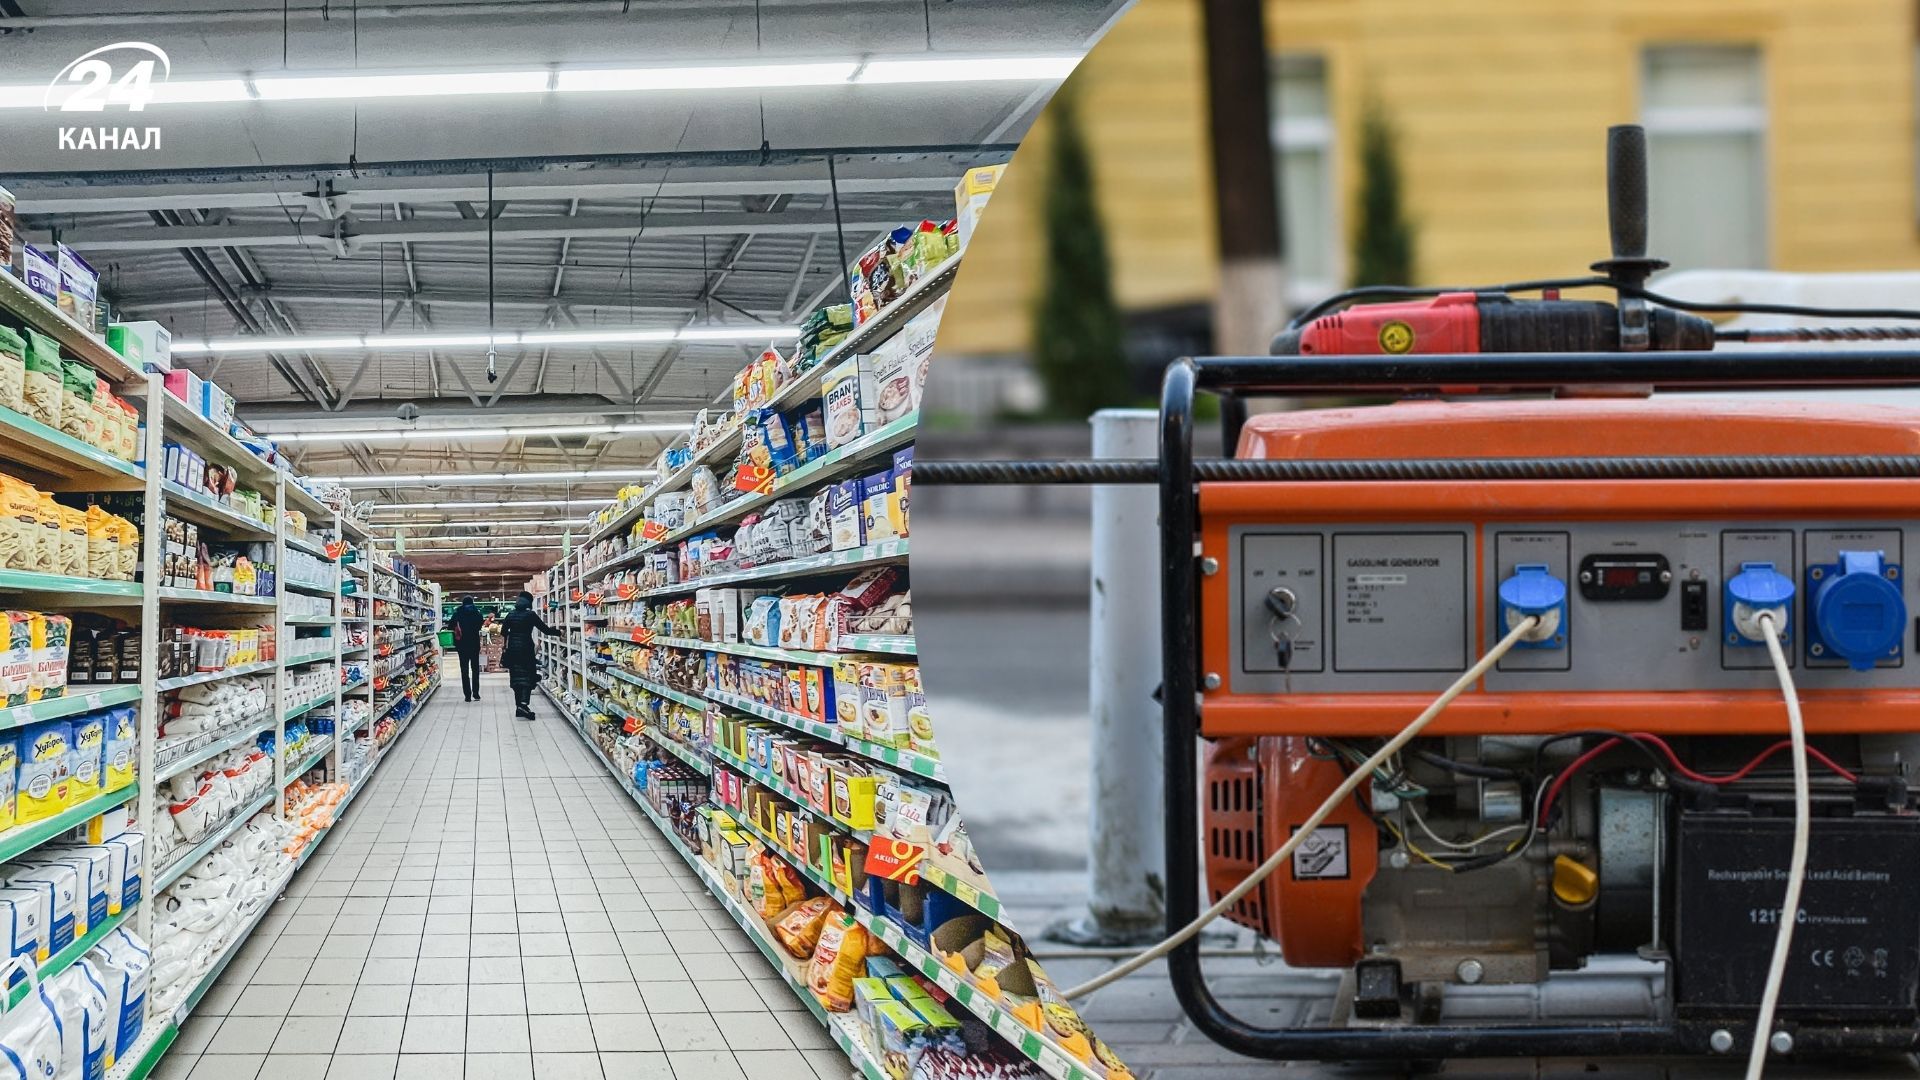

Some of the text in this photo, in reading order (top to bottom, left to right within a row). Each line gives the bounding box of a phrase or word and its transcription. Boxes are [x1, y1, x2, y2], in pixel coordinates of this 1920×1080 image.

[828, 382, 852, 405] BRAN
[829, 395, 852, 412] FLAKES
[866, 482, 890, 495] NORDIC
[1347, 558, 1440, 568] GASOLINE GENERATOR
[34, 736, 65, 759] Хуторок
[874, 853, 899, 865] АКЦІЯ
[1708, 869, 1772, 883] Rechargeable
[1808, 869, 1831, 881] Lead
[1832, 869, 1853, 881] Acid
[1855, 869, 1890, 882] Battery
